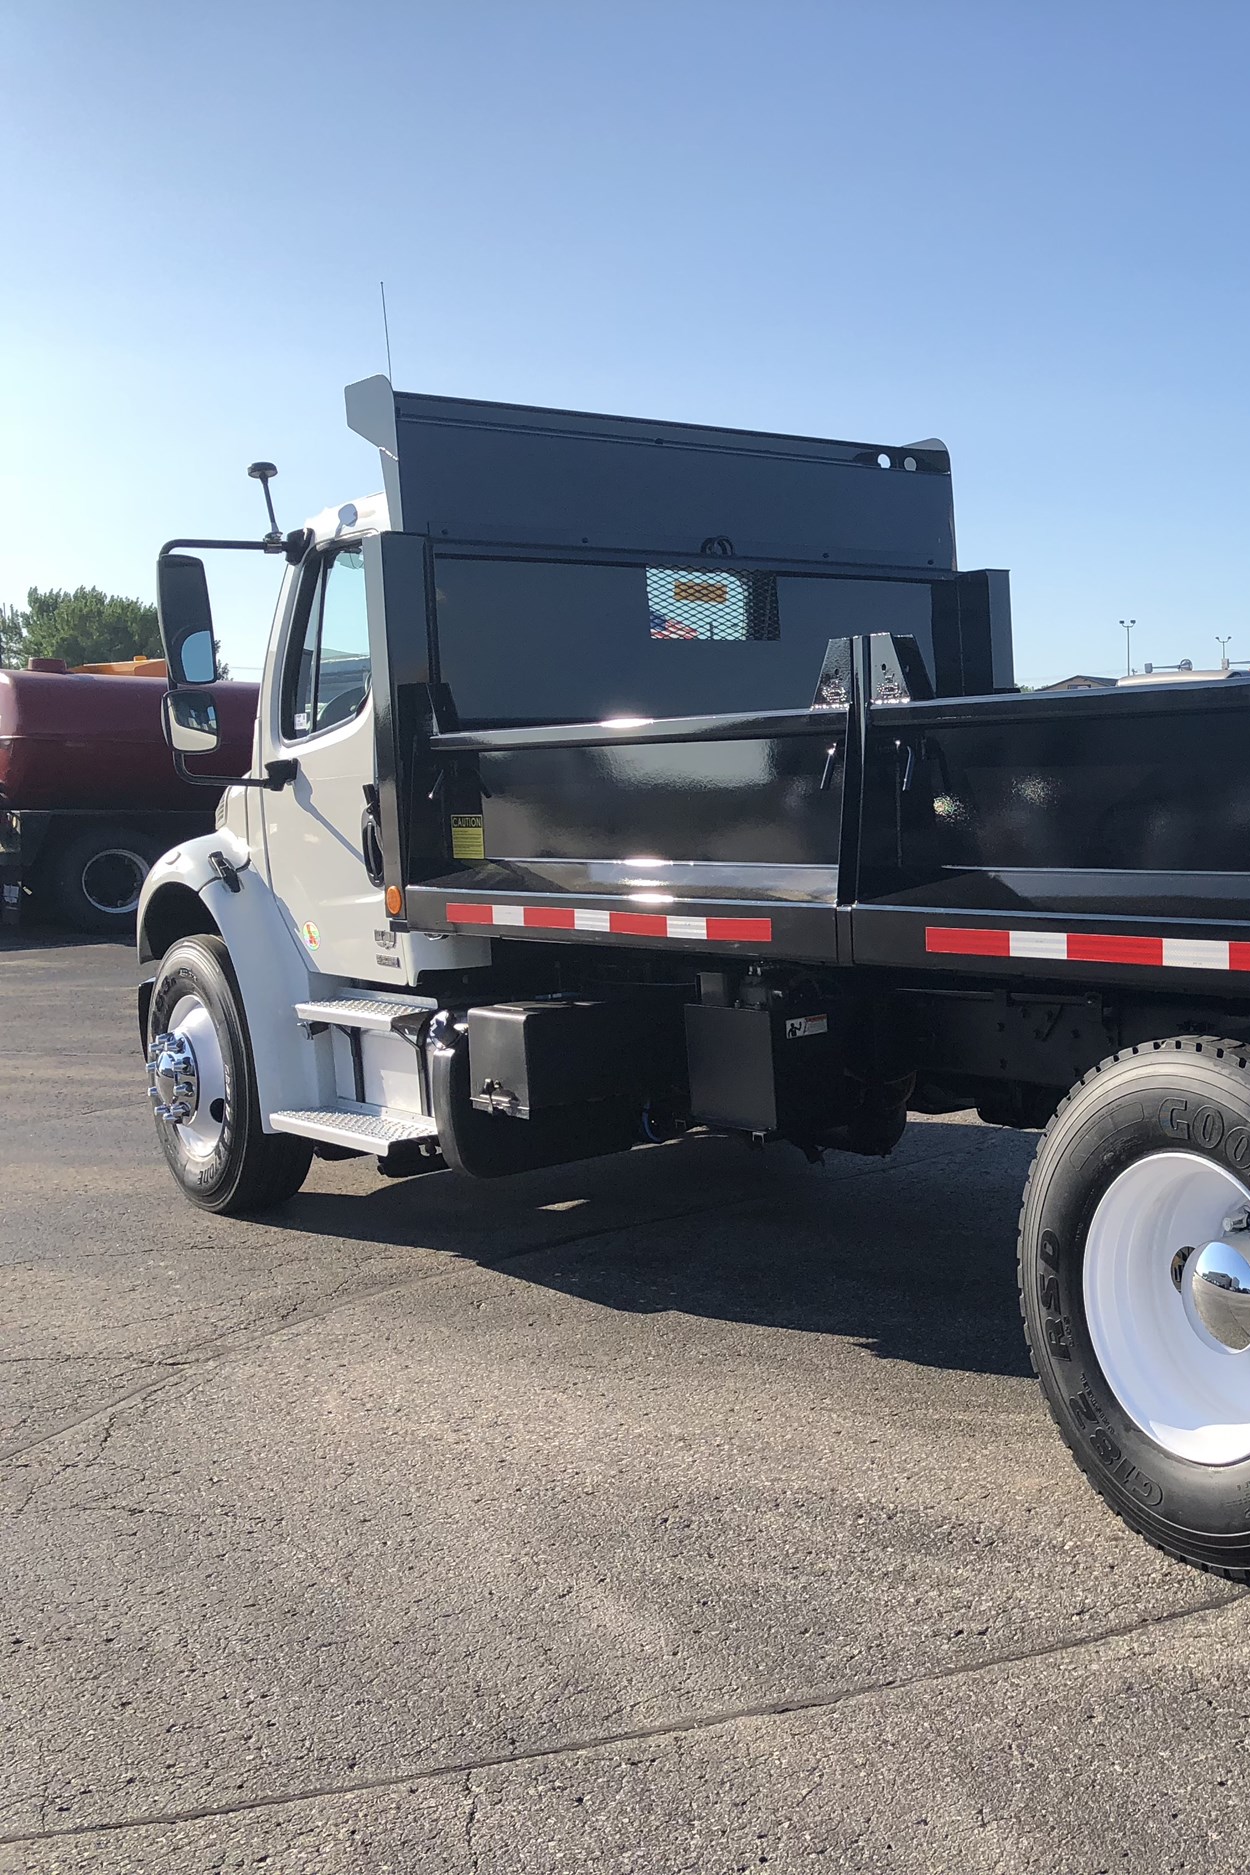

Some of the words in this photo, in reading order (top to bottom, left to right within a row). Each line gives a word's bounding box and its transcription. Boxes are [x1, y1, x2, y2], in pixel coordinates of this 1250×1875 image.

[452, 817, 482, 827] CAUTION
[1038, 1228, 1072, 1362] RSD
[1069, 1390, 1163, 1506] G182
